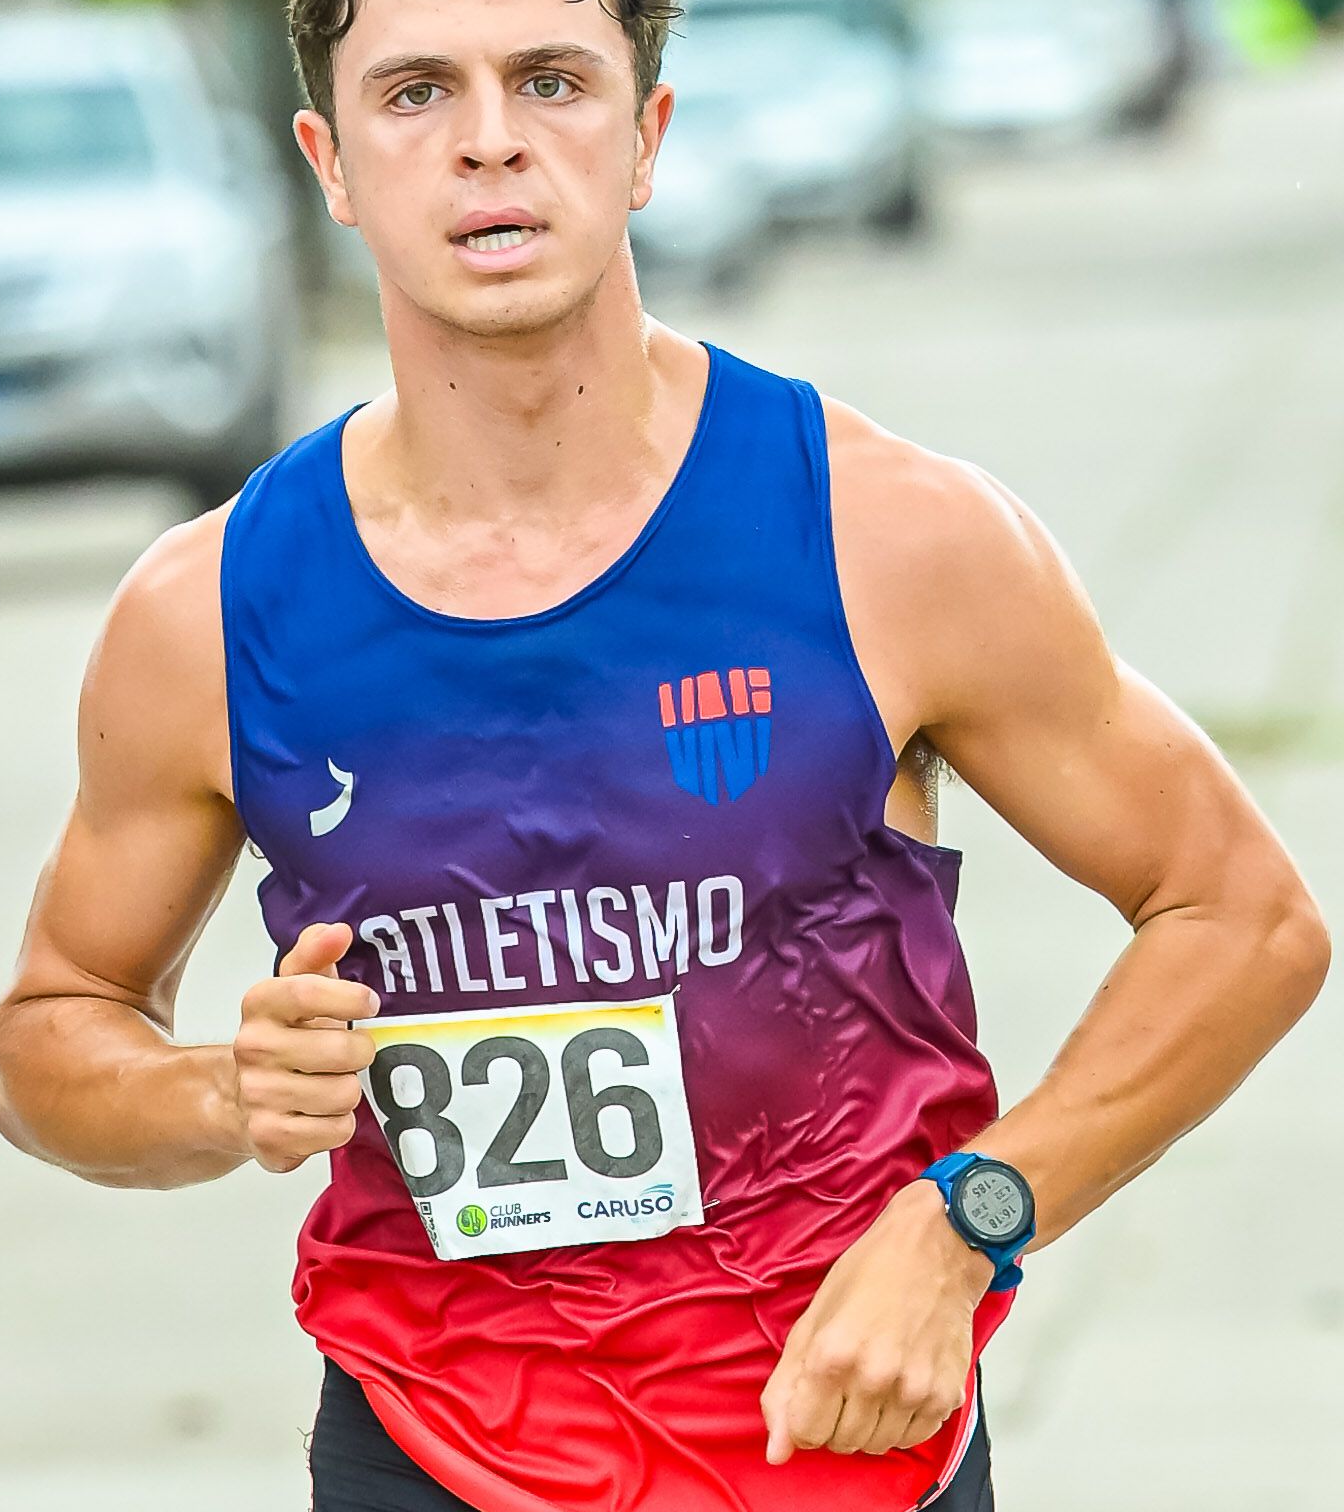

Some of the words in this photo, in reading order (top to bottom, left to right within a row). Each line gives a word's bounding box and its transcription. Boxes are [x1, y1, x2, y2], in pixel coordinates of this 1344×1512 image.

[358, 875, 744, 993] ATLETISMO
[368, 1027, 663, 1199] 826
[490, 1203, 521, 1217] CLUB
[577, 1195, 673, 1218] CARUSO
[490, 1211, 551, 1229] RUNNER'S
